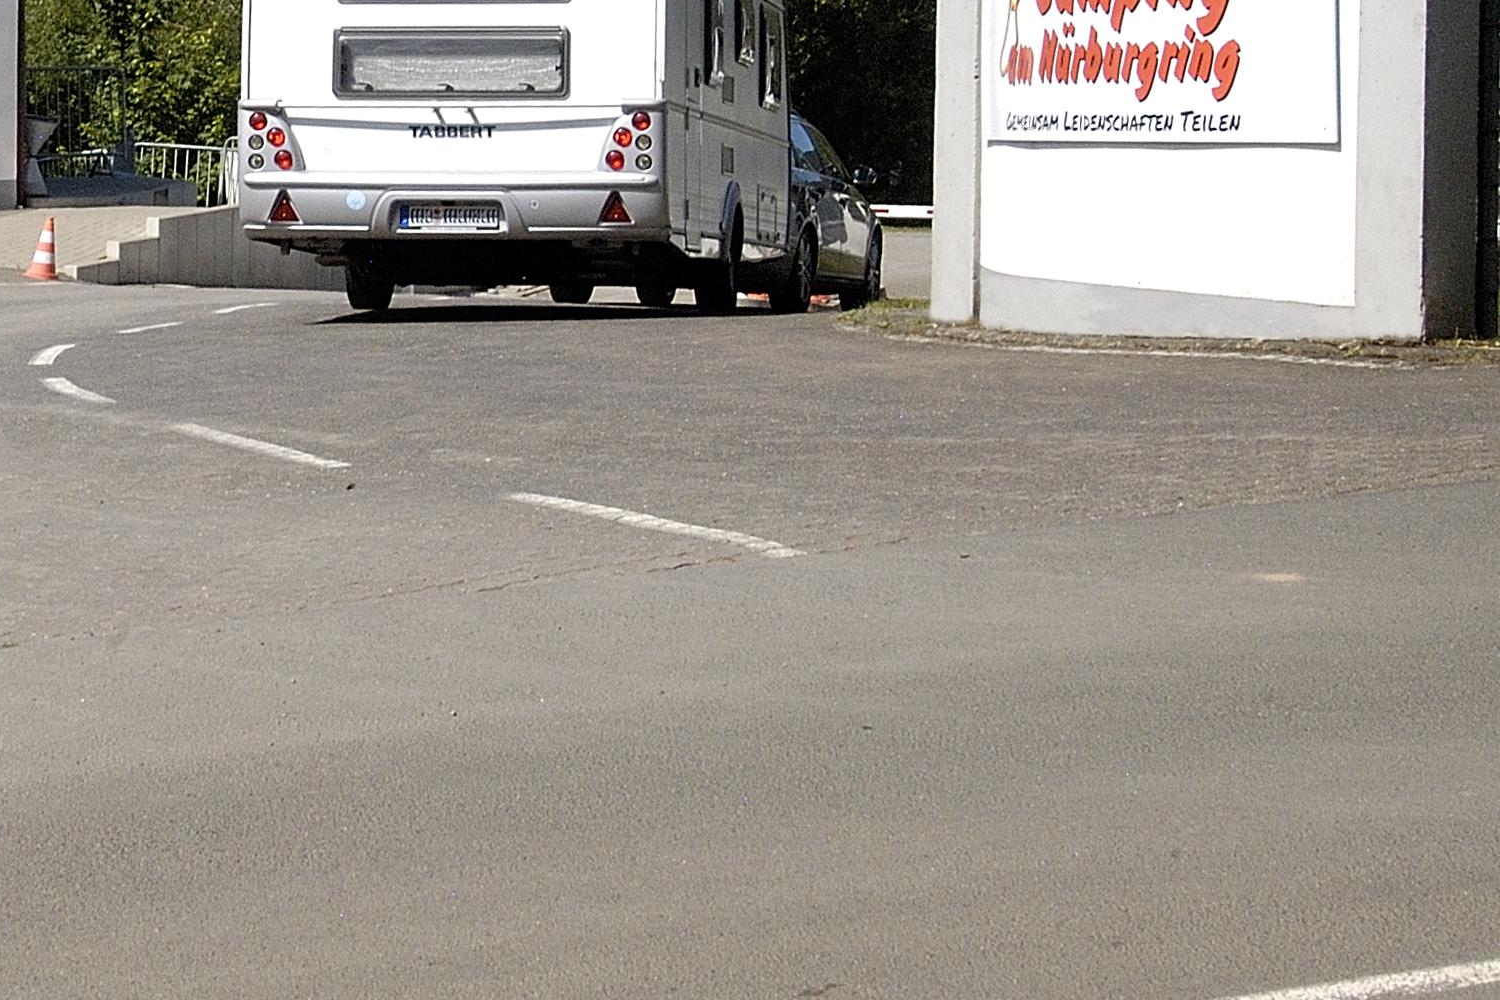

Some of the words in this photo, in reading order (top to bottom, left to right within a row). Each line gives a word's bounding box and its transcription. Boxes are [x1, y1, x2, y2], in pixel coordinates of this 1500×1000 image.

[1007, 44, 1035, 86] am
[1038, 22, 1242, 102] Nürburgring
[408, 125, 497, 139] TABBERT
[1006, 112, 1059, 131] GEMEINSAM
[1063, 111, 1174, 131] LEIDENSCHAFTEN
[1180, 110, 1241, 132] TEILEN
